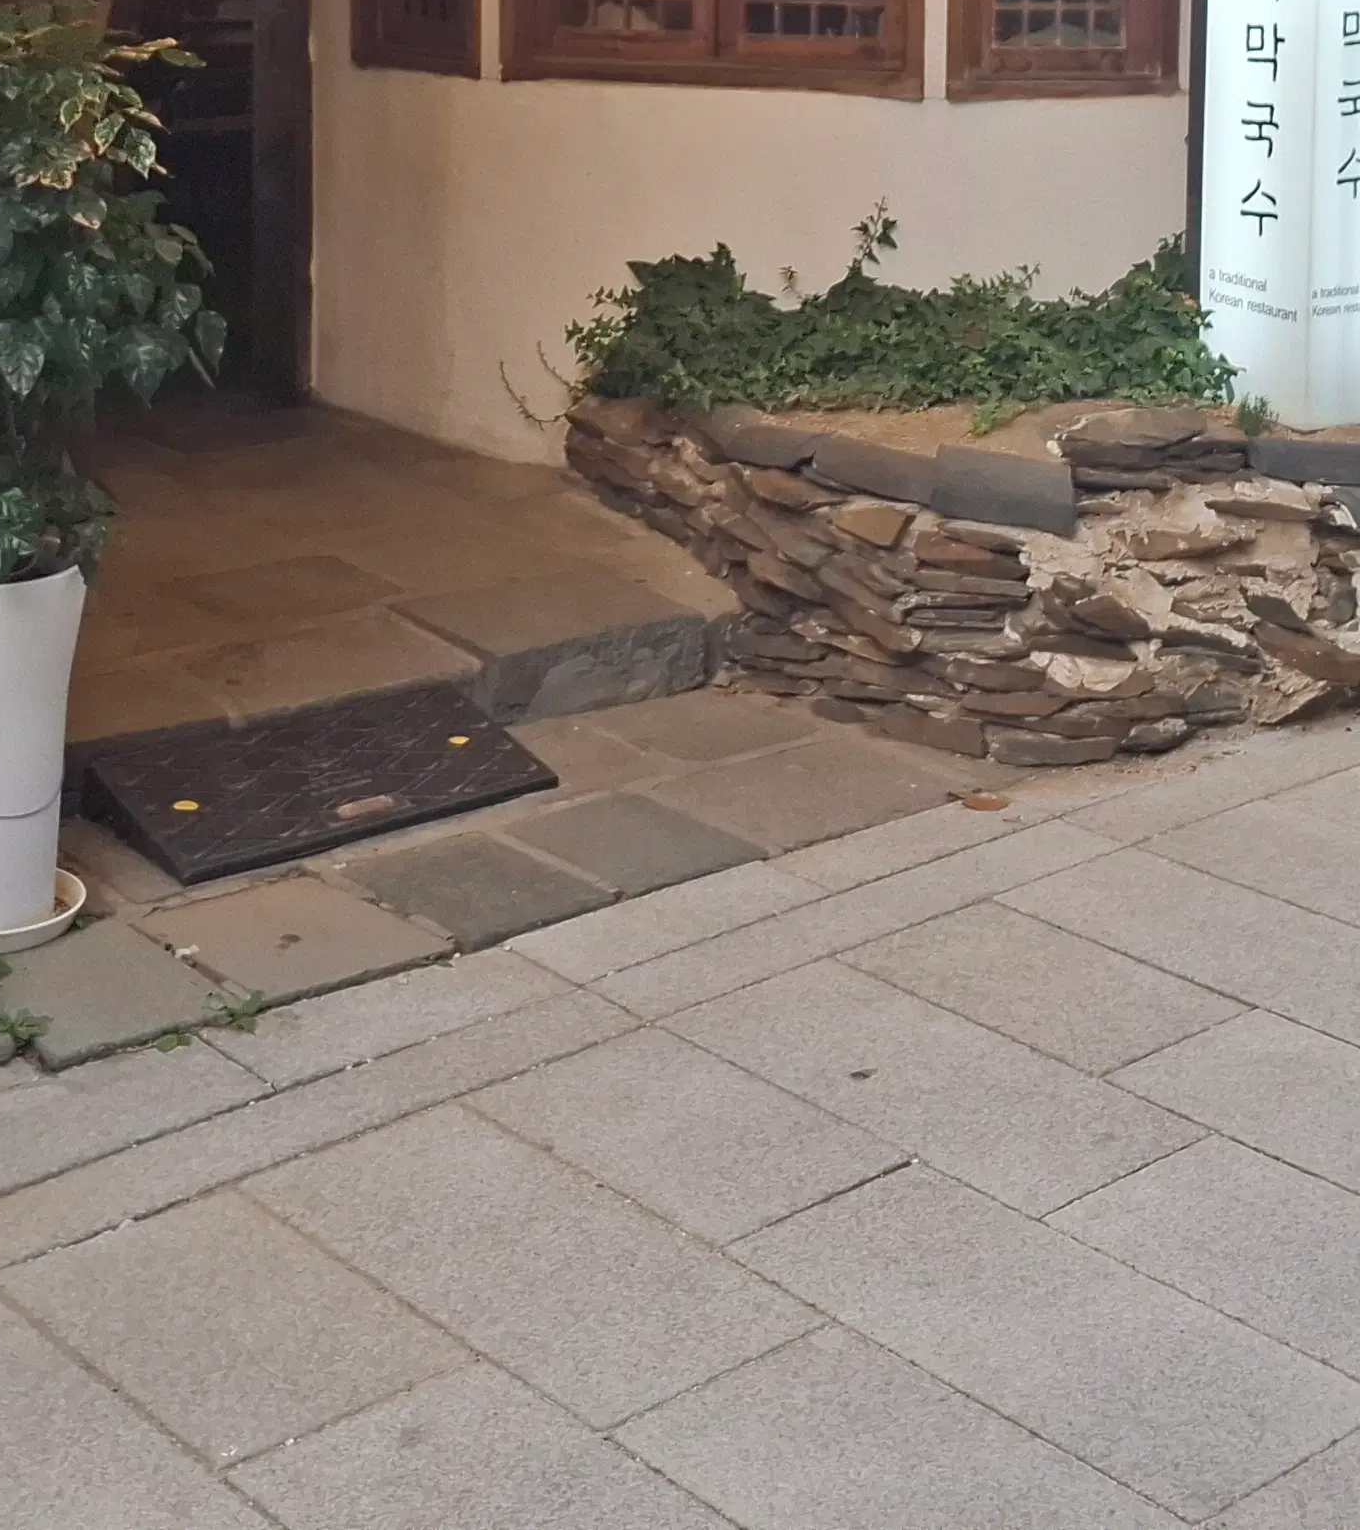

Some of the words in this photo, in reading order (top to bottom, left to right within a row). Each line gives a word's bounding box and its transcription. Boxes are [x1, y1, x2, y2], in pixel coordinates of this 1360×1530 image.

[1209, 269, 1216, 280] a
[1219, 270, 1268, 292] traditional
[1320, 283, 1360, 298] traditional
[1209, 289, 1243, 310] Korean
[1247, 300, 1298, 323] restaurant
[1312, 304, 1341, 318] Korean
